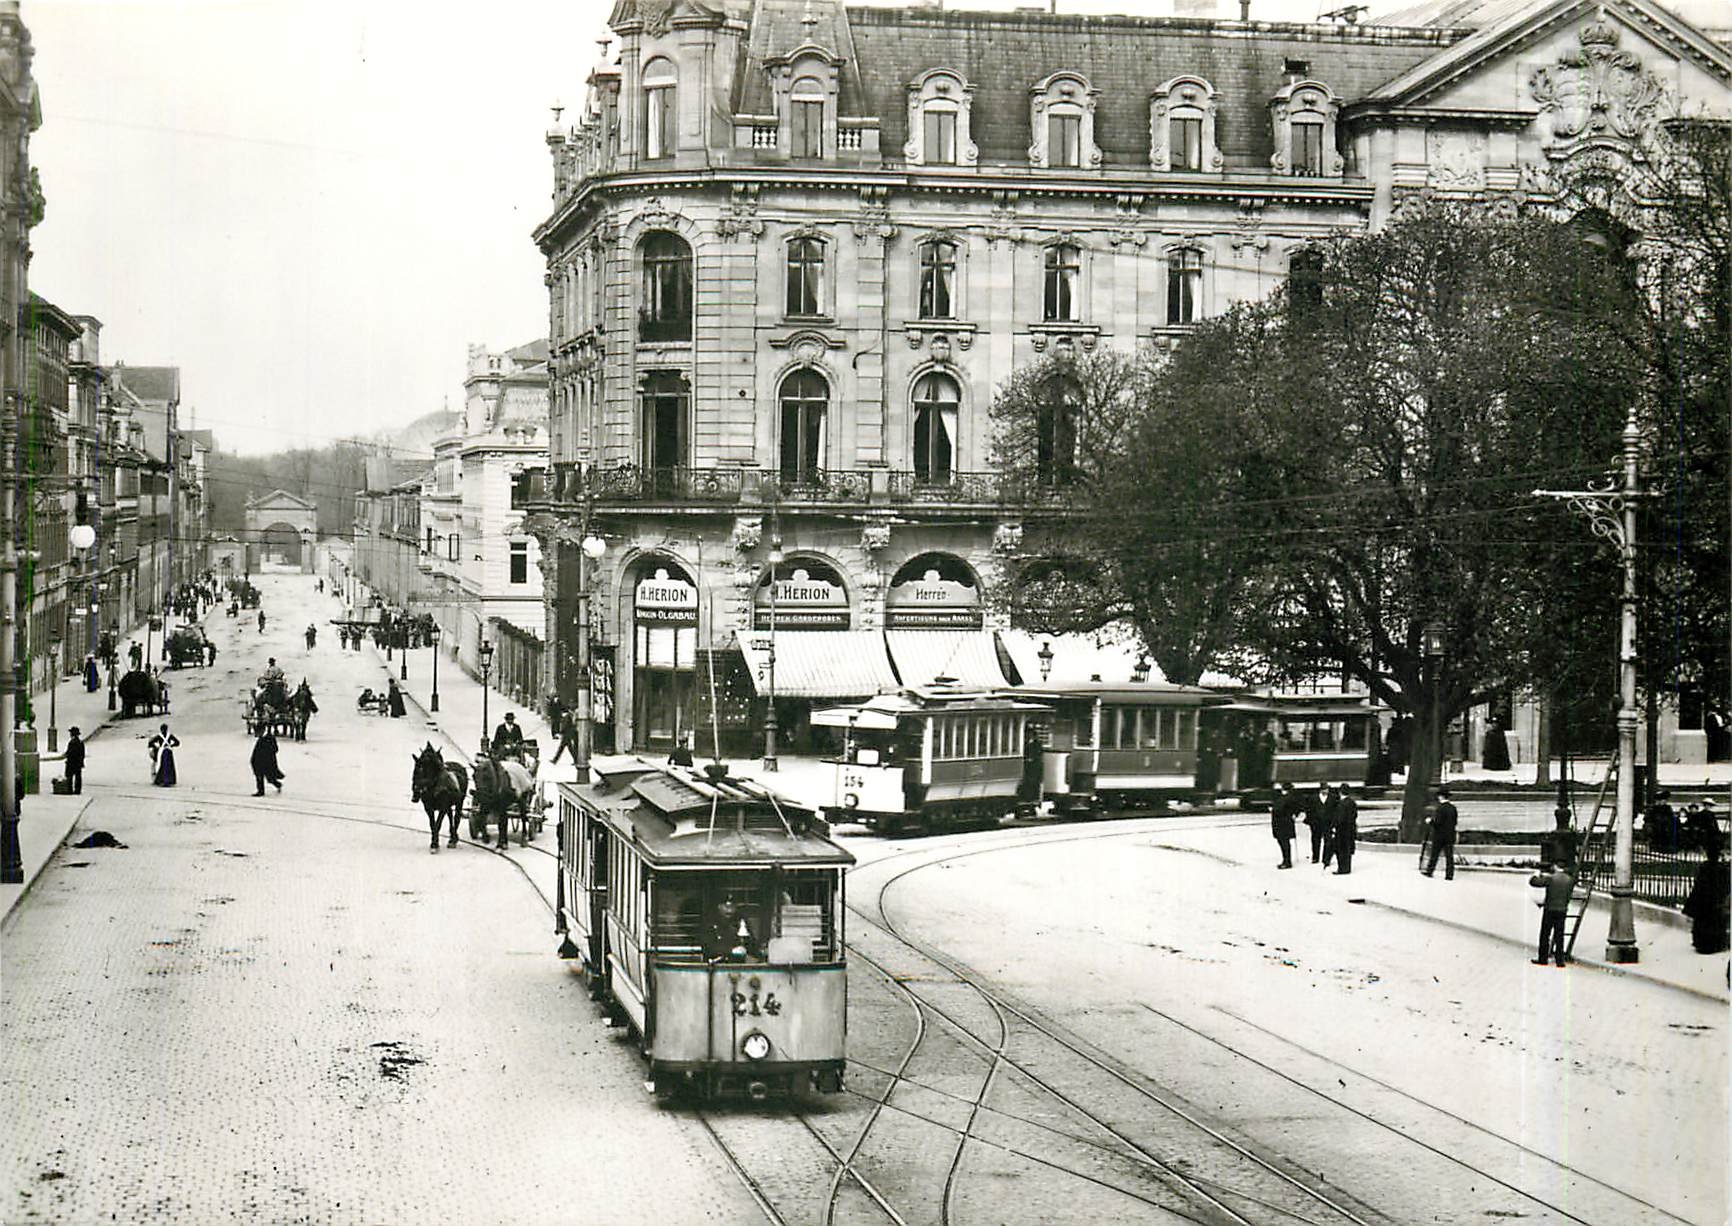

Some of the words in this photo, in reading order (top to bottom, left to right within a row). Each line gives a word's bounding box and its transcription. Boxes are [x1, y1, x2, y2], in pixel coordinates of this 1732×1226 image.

[640, 586, 688, 602] H.HERION
[844, 775, 864, 788] 154
[730, 991, 783, 1017] 214
